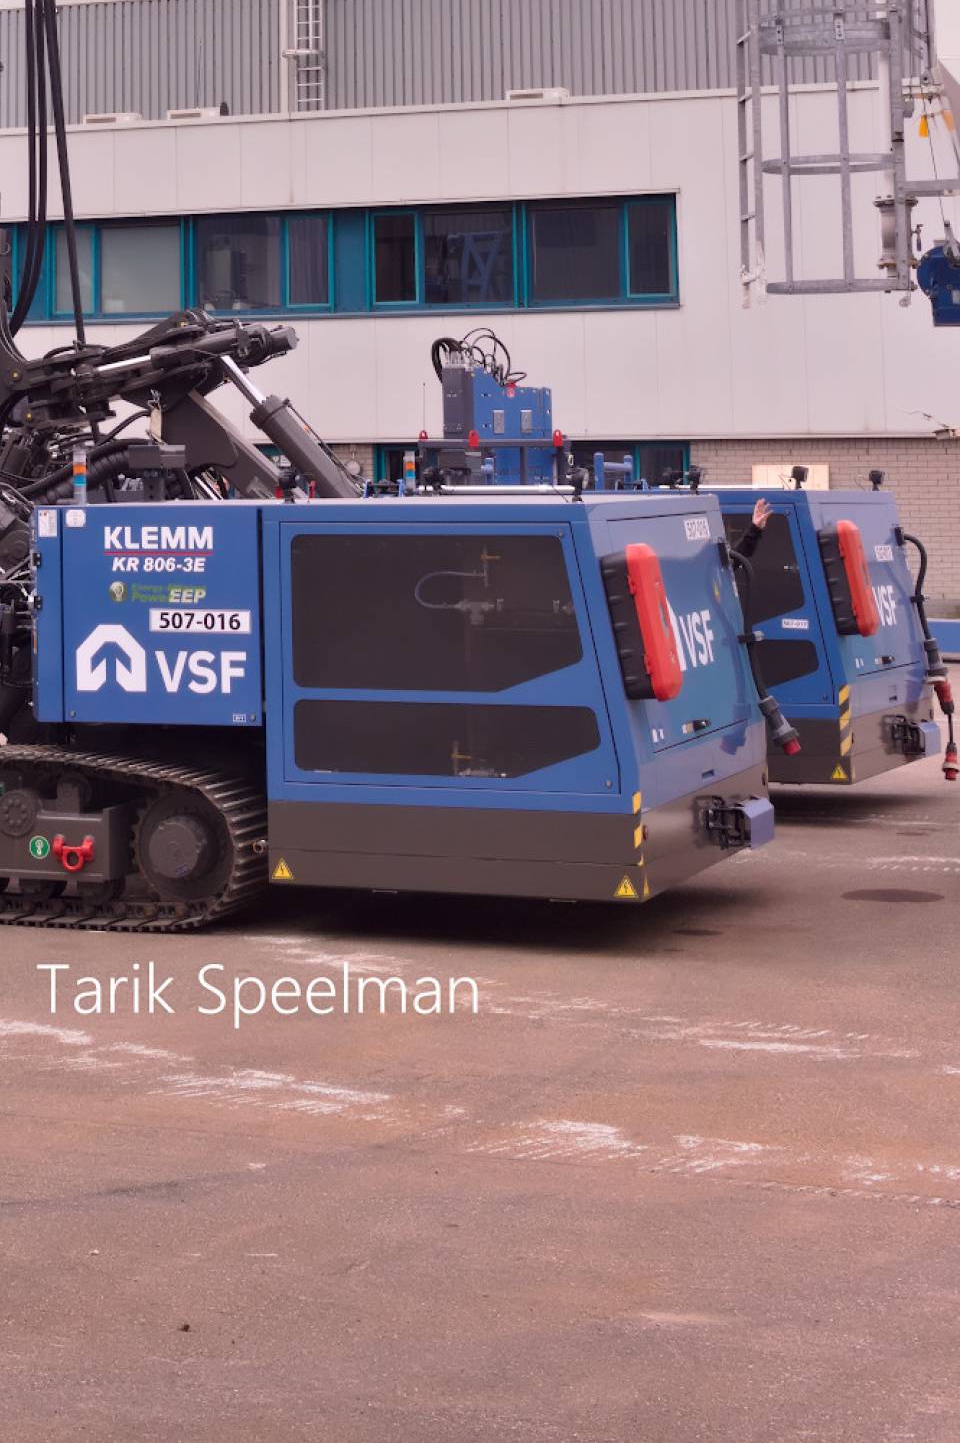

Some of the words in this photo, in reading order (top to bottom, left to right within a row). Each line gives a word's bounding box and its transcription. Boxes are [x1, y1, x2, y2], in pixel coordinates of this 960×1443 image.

[103, 526, 214, 550] KLEMM
[112, 558, 138, 572] KR
[143, 558, 206, 572] 806-3E
[168, 588, 207, 604] EEP
[872, 584, 897, 627] VSF
[159, 612, 241, 631] 507-016
[679, 609, 715, 668] VSF
[154, 650, 247, 694] VSF
